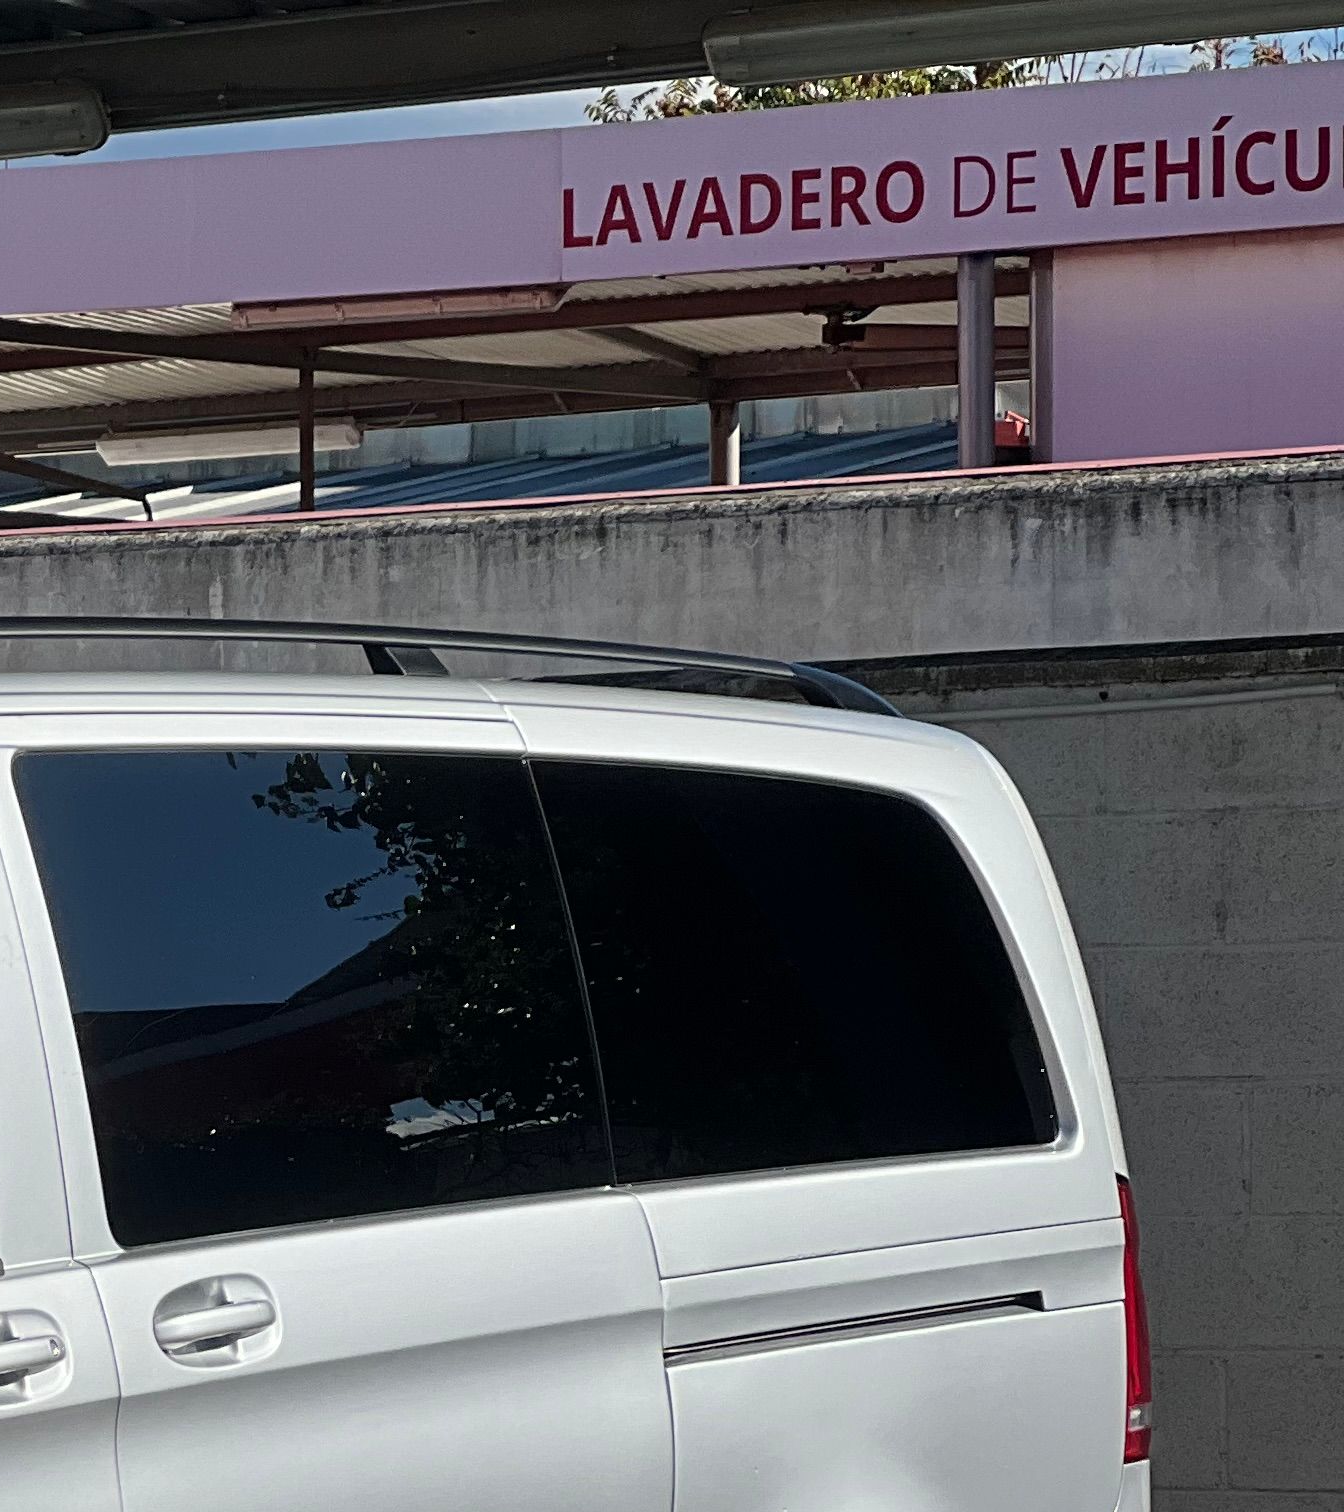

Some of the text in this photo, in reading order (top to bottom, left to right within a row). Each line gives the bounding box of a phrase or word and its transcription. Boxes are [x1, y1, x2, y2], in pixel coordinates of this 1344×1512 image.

[562, 114, 1344, 249] LAVADERO DE VEHÍCU
